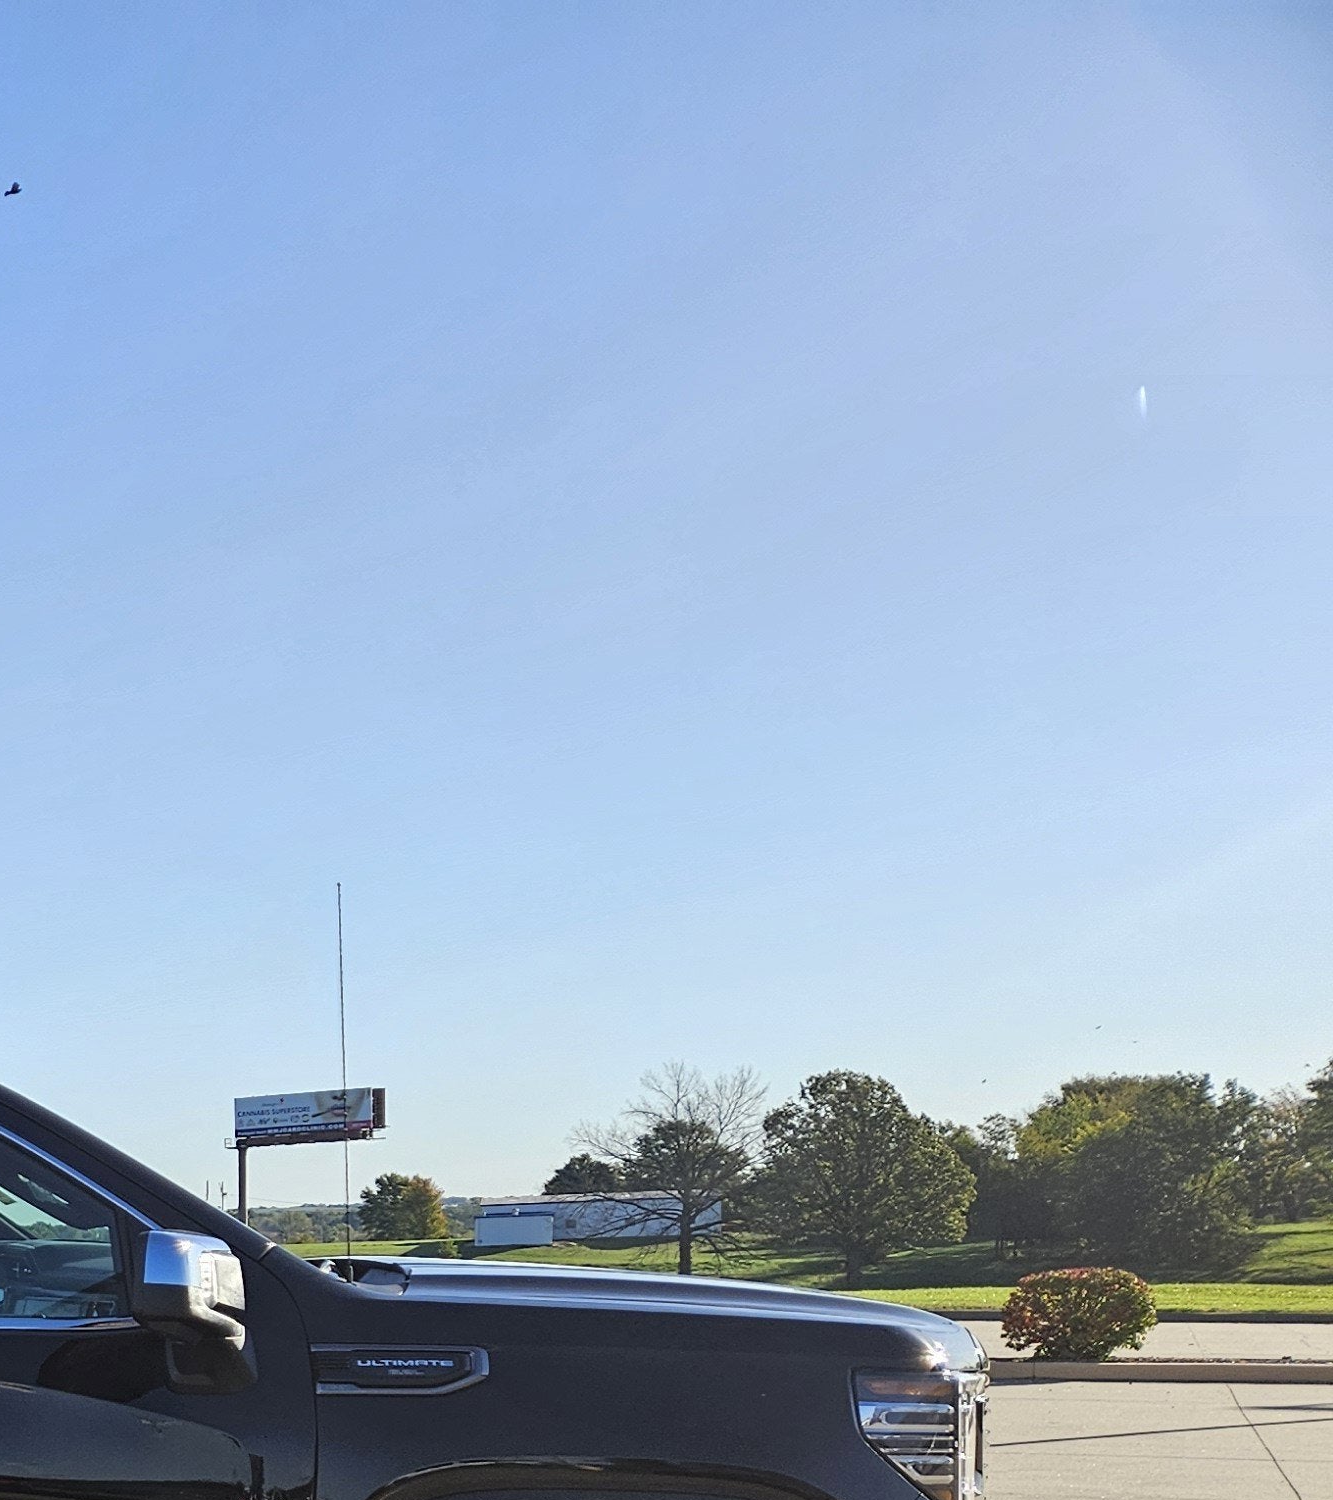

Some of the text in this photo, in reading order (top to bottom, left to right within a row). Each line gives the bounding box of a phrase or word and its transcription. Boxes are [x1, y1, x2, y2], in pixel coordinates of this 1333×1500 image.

[237, 1106, 310, 1118] CANNABIS SUPERSTORE
[357, 1359, 454, 1367] ULTIMATE
